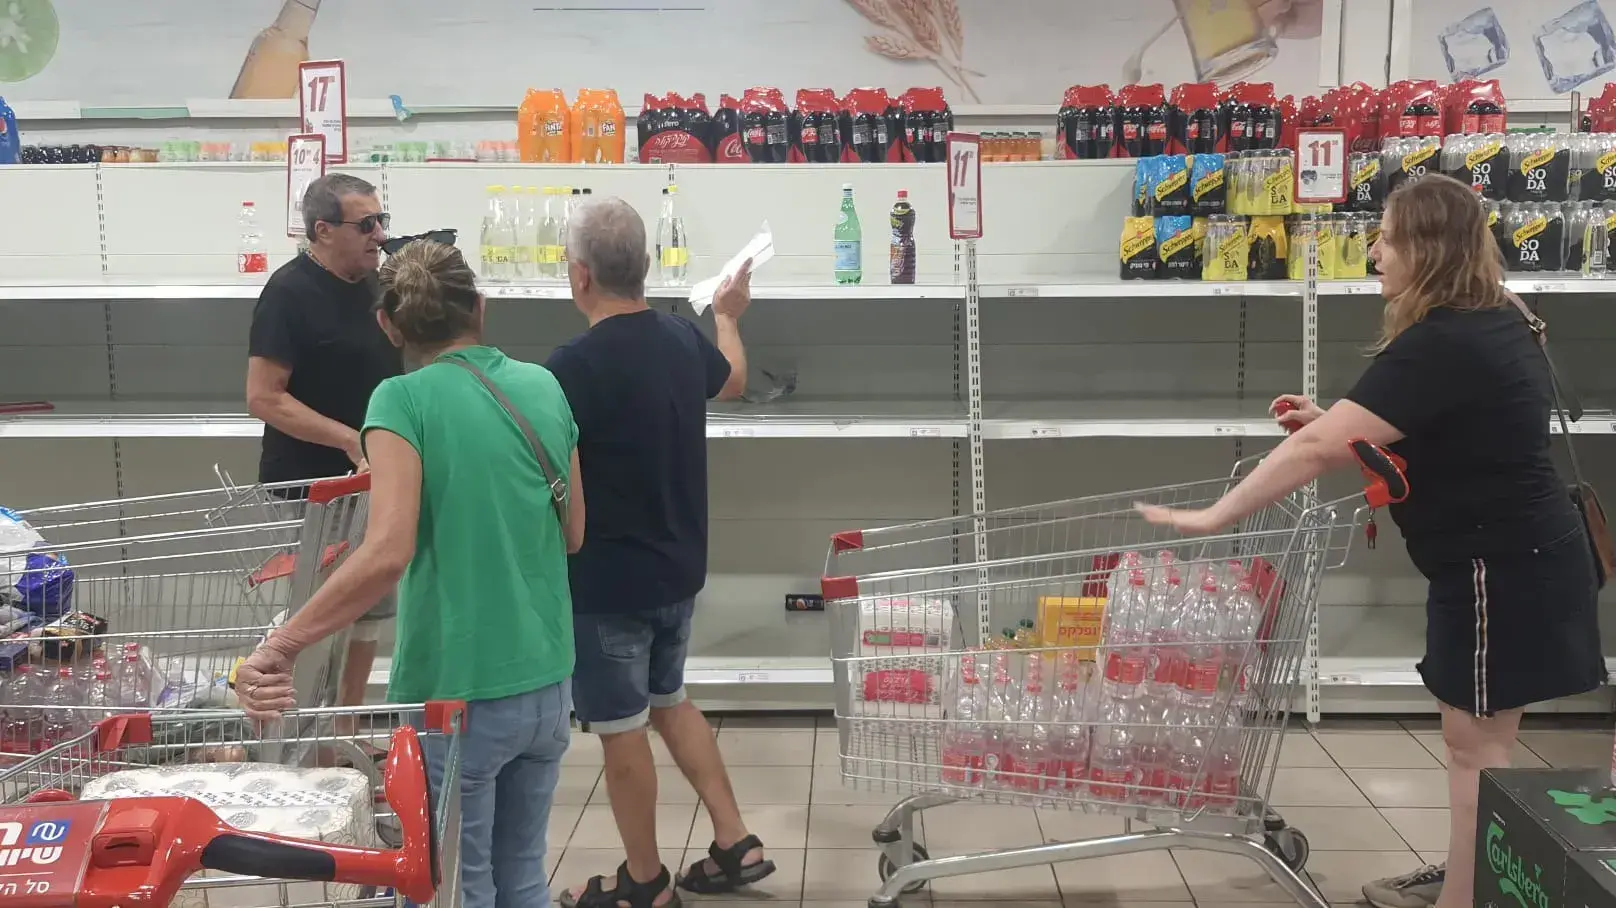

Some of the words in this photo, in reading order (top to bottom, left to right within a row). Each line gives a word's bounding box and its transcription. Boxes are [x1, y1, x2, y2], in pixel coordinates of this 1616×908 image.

[1308, 140, 1331, 166] 11
[1408, 165, 1426, 177] SO
[1473, 163, 1491, 174] SO
[1528, 168, 1547, 180] SO
[1472, 174, 1491, 185] DA
[1526, 180, 1546, 190] DA
[1357, 183, 1370, 192] SO
[1357, 192, 1372, 201] DA
[1521, 240, 1539, 250] SO
[1520, 251, 1540, 261] DA
[25, 879, 50, 894] סל
